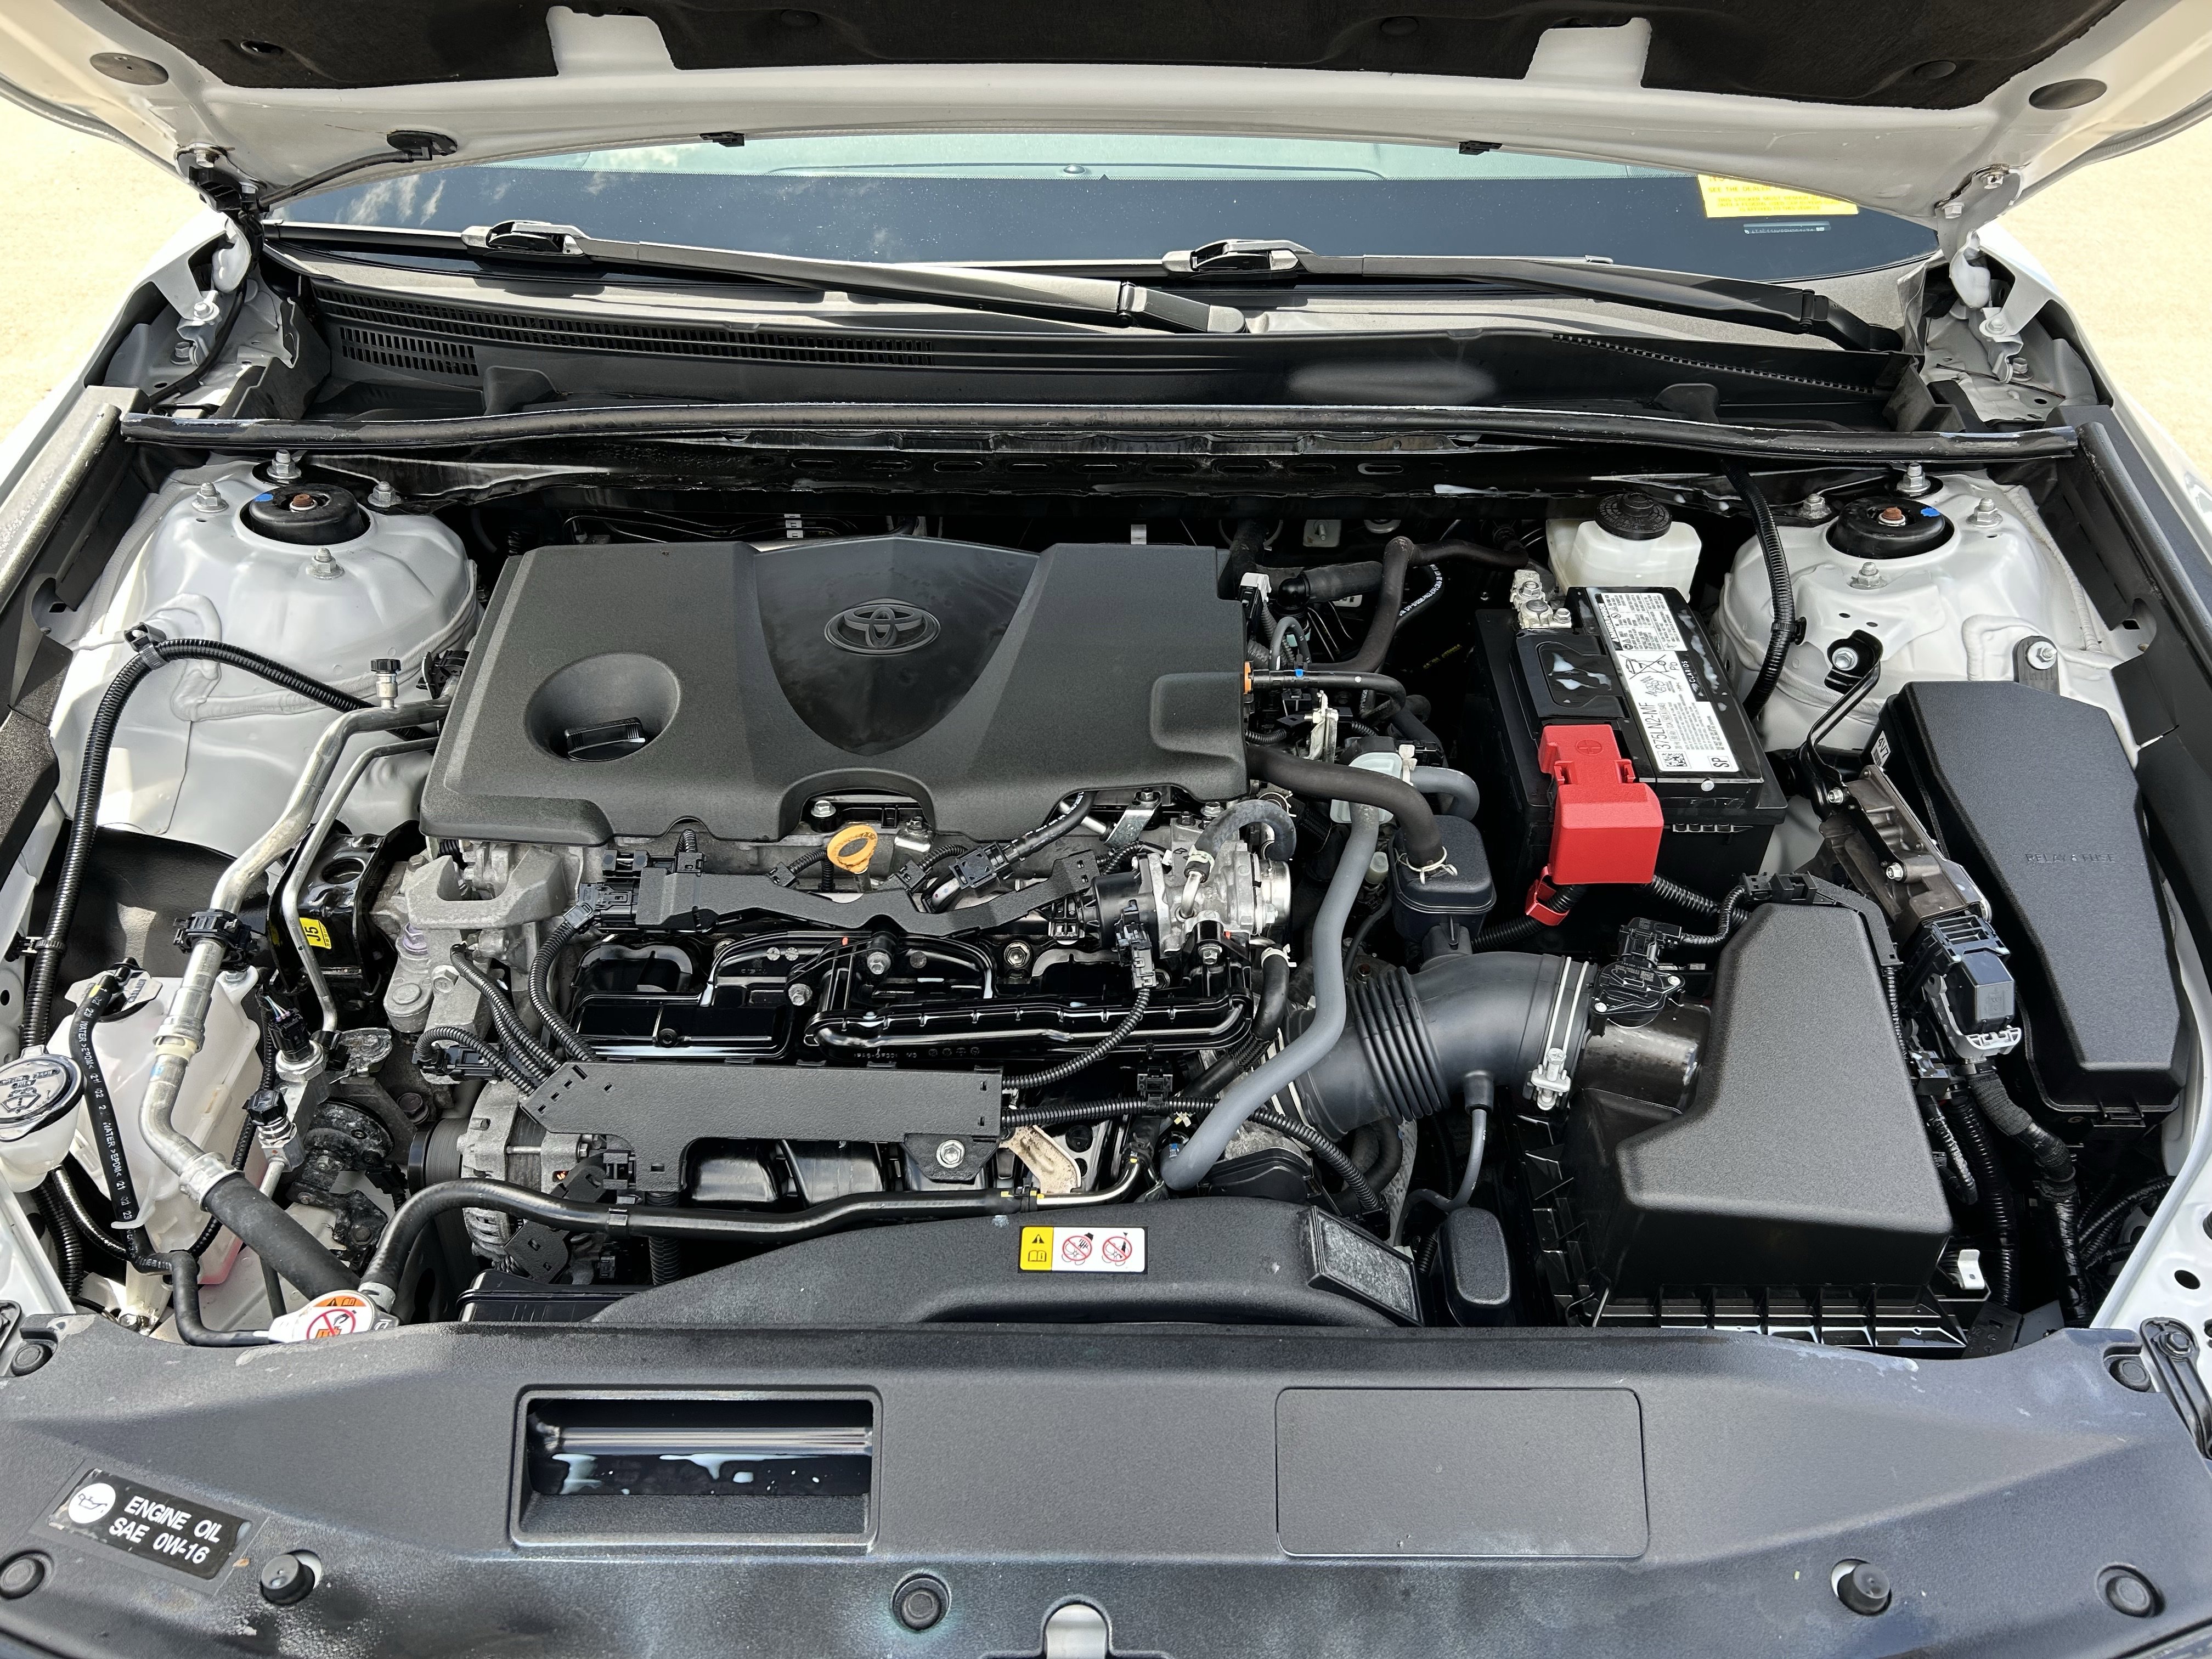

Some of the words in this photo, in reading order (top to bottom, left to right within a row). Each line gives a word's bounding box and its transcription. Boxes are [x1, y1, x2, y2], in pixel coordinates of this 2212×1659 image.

[1669, 662, 1680, 671] Pb
[1681, 661, 1696, 684] CLARIOS
[1638, 702, 1672, 749] 375LN2-MF
[1878, 737, 1889, 759] 4V7
[1711, 757, 1730, 768] SP
[2025, 853, 2066, 864] RELAY
[2081, 853, 2117, 864] FUSE
[306, 926, 320, 943] J5
[78, 1020, 89, 1046] WATER
[125, 1496, 191, 1530] ENGINE
[194, 1520, 222, 1543] OIL
[109, 1517, 150, 1543] SAE
[153, 1533, 210, 1564] 0W-16
